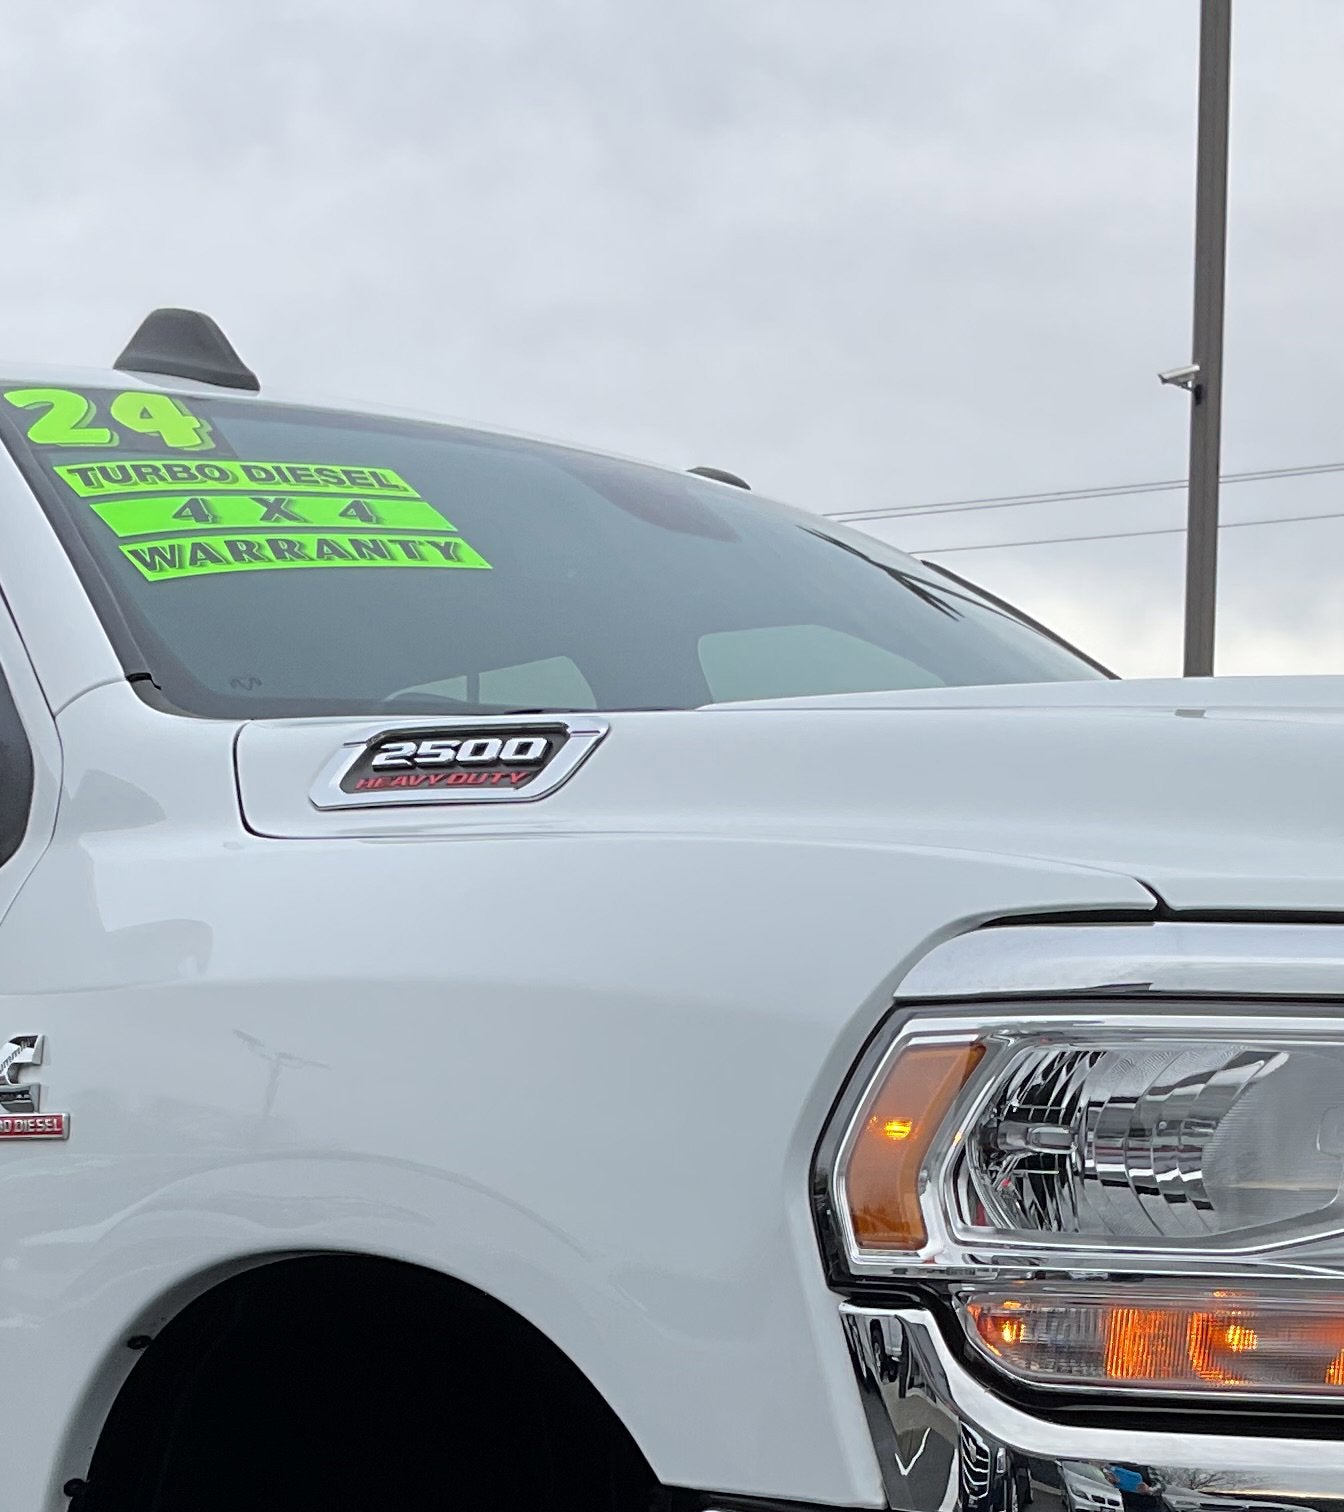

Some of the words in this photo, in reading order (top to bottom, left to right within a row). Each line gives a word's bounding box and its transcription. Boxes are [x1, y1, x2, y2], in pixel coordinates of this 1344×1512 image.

[3, 388, 217, 451] 24
[67, 463, 233, 490] TURBO
[242, 463, 404, 491] DIESEL
[172, 497, 216, 524] 4
[338, 499, 375, 524] 4
[127, 538, 459, 573] WARRANTY
[371, 737, 554, 772] 2500
[355, 773, 442, 790] HEAVY
[445, 771, 530, 787] DUTY
[13, 1118, 62, 1133] DIESEL
